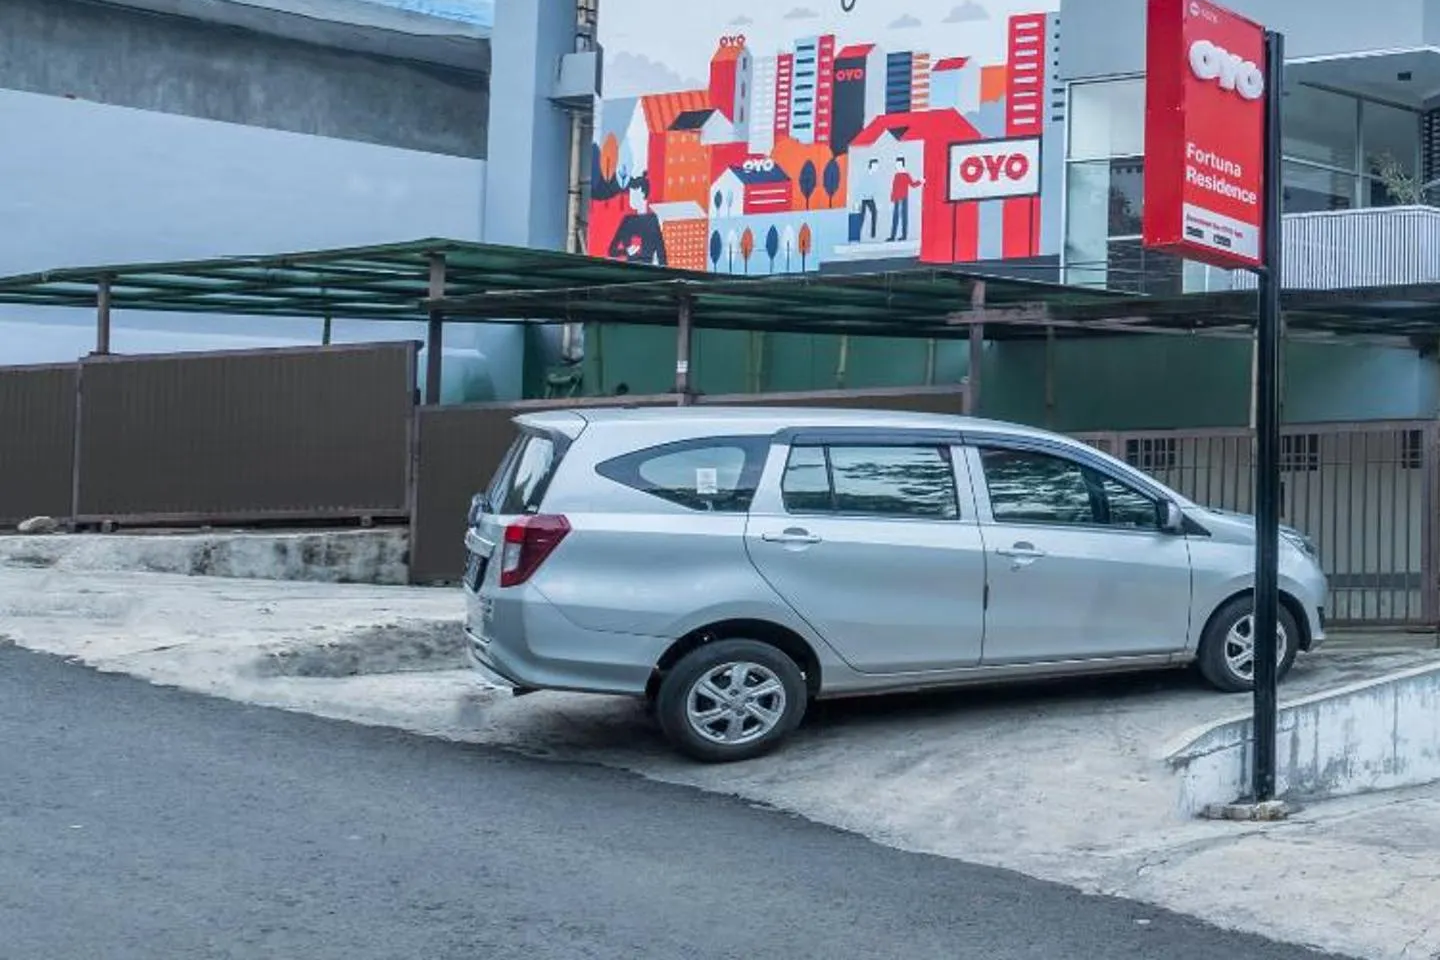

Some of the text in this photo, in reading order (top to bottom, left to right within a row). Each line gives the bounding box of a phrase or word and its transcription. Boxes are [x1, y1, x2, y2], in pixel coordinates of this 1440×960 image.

[719, 34, 746, 48] OYO
[836, 68, 863, 81] OYO
[1189, 40, 1264, 100] OYO
[743, 157, 774, 173] OYO
[959, 153, 1030, 186] OYO
[1186, 142, 1242, 178] Fortuna
[1186, 165, 1257, 205] Residence
